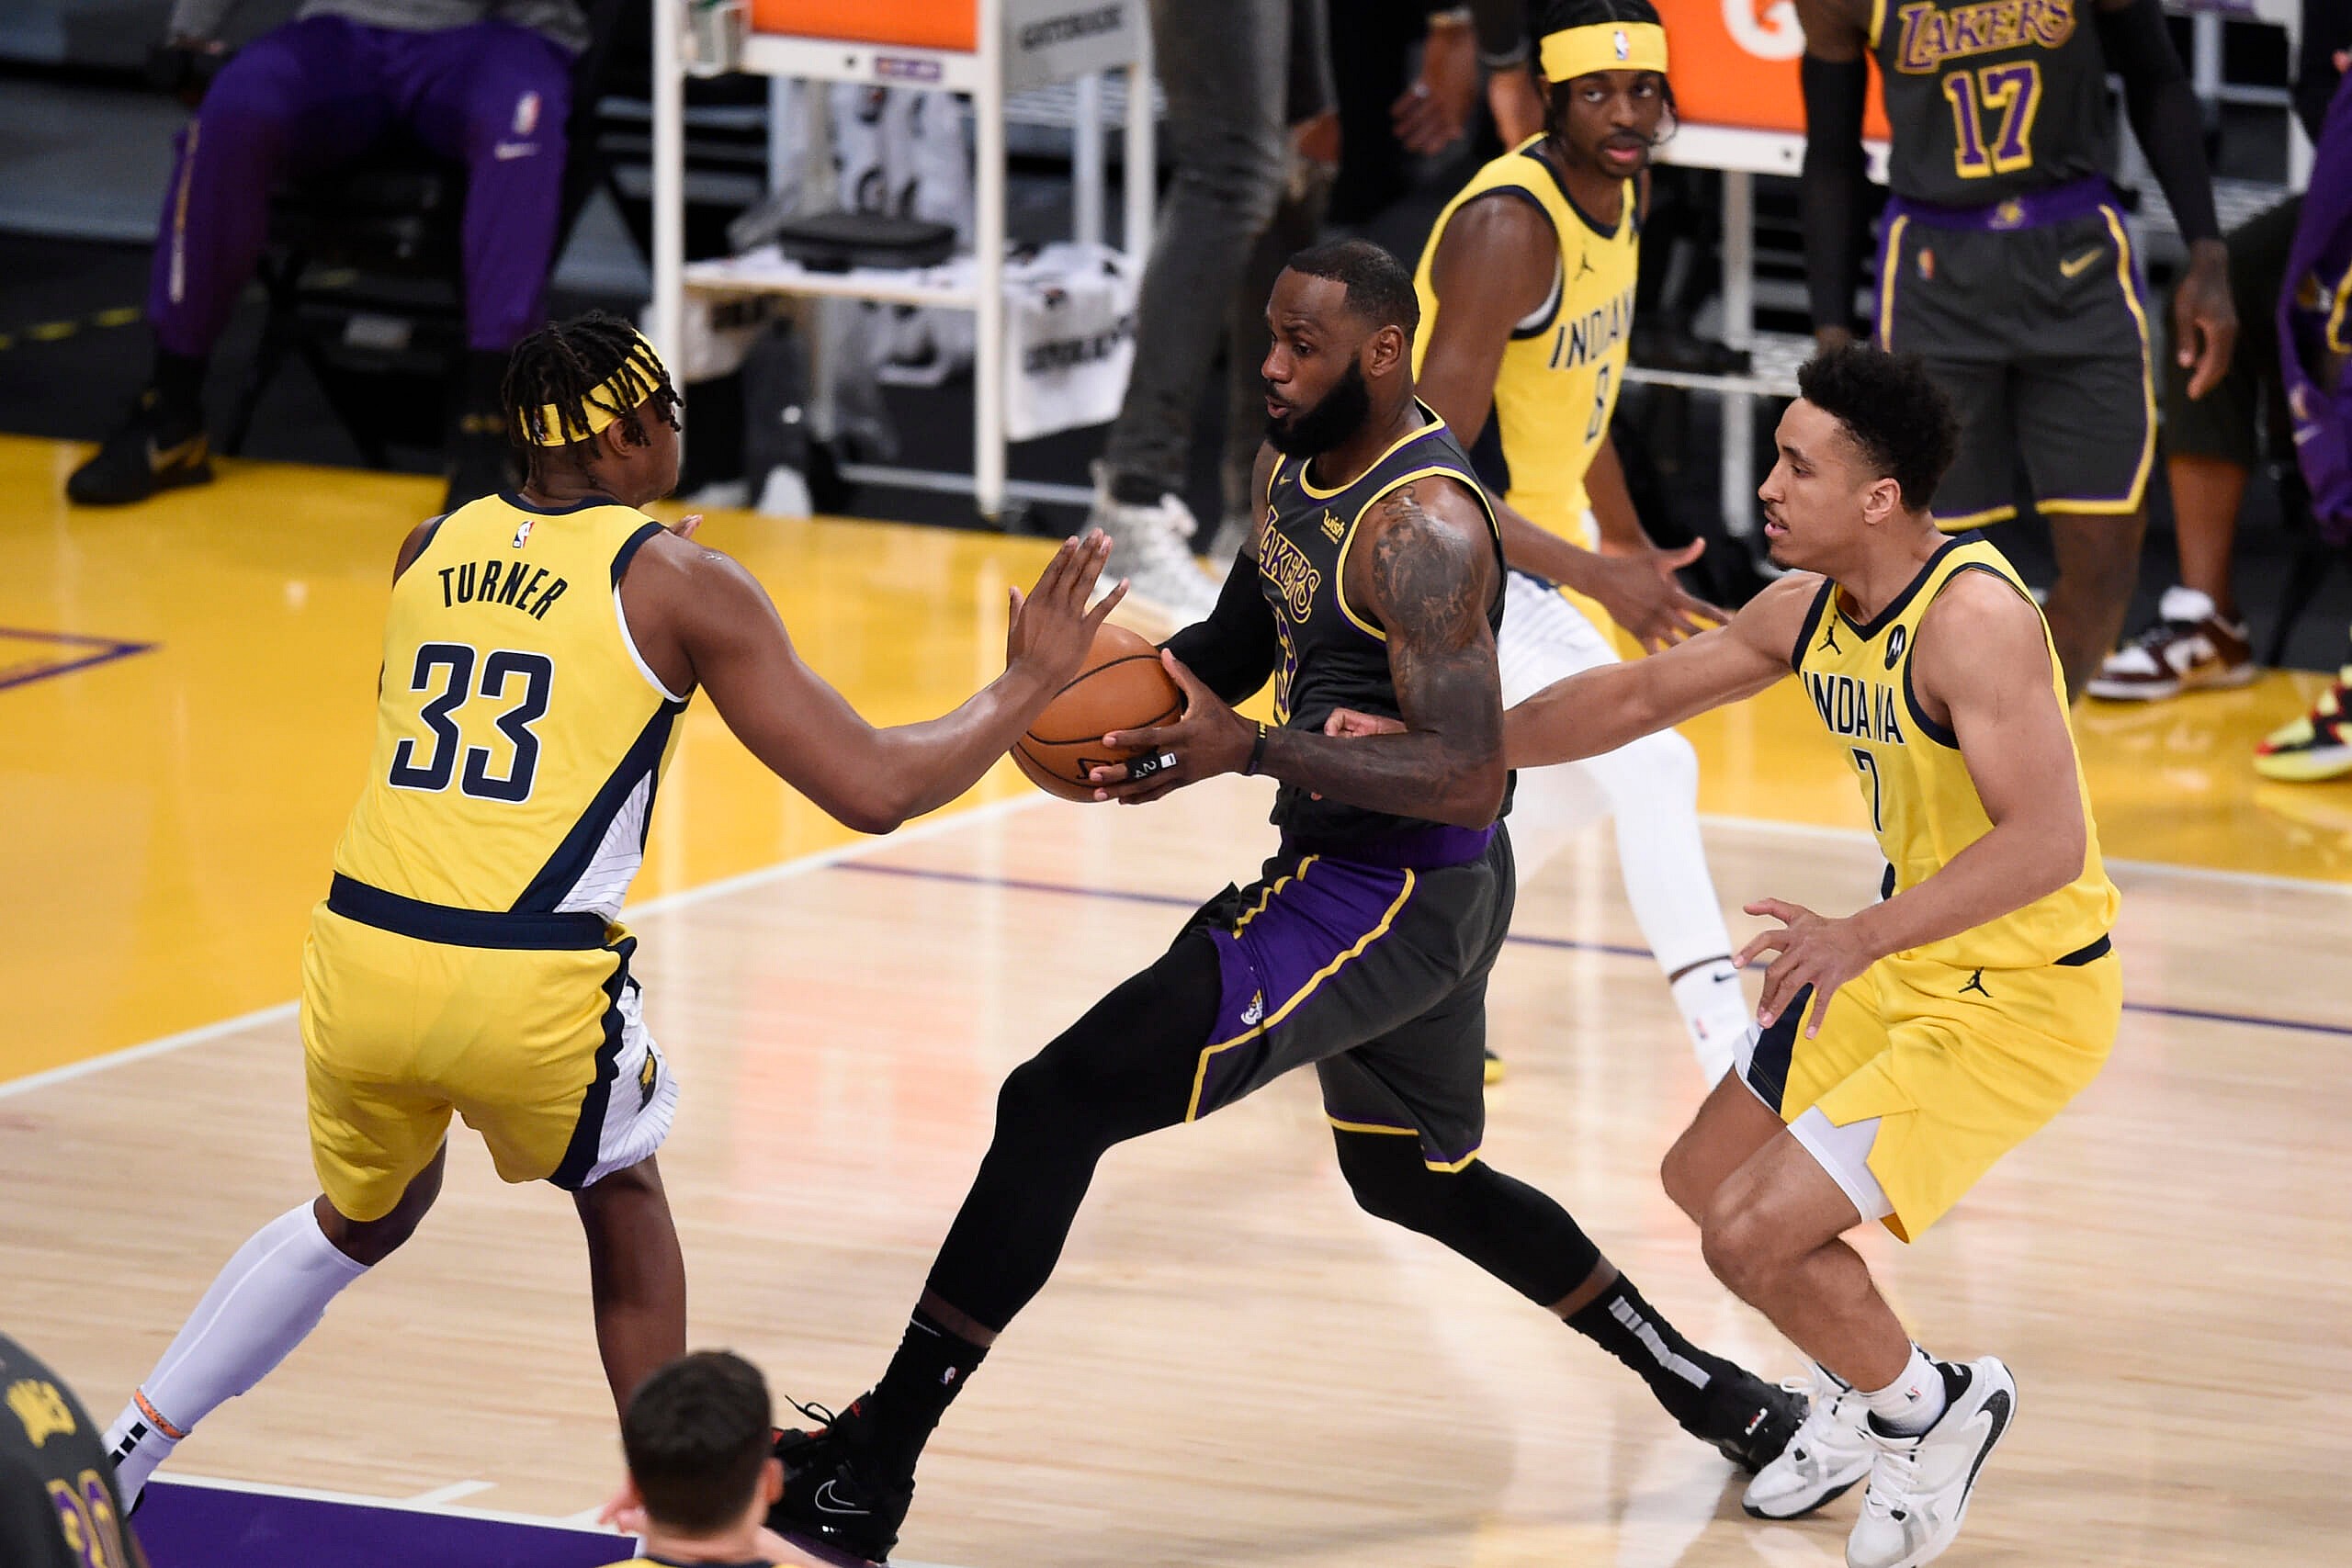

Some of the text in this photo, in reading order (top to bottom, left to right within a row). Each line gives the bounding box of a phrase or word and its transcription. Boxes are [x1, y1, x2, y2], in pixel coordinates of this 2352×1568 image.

[1894, 0, 2075, 74] LAKERS
[1941, 60, 2042, 178] 17
[1323, 507, 1346, 539] wish
[437, 558, 568, 621] TURNER
[389, 640, 555, 806] 33
[1850, 745, 1883, 833] 7
